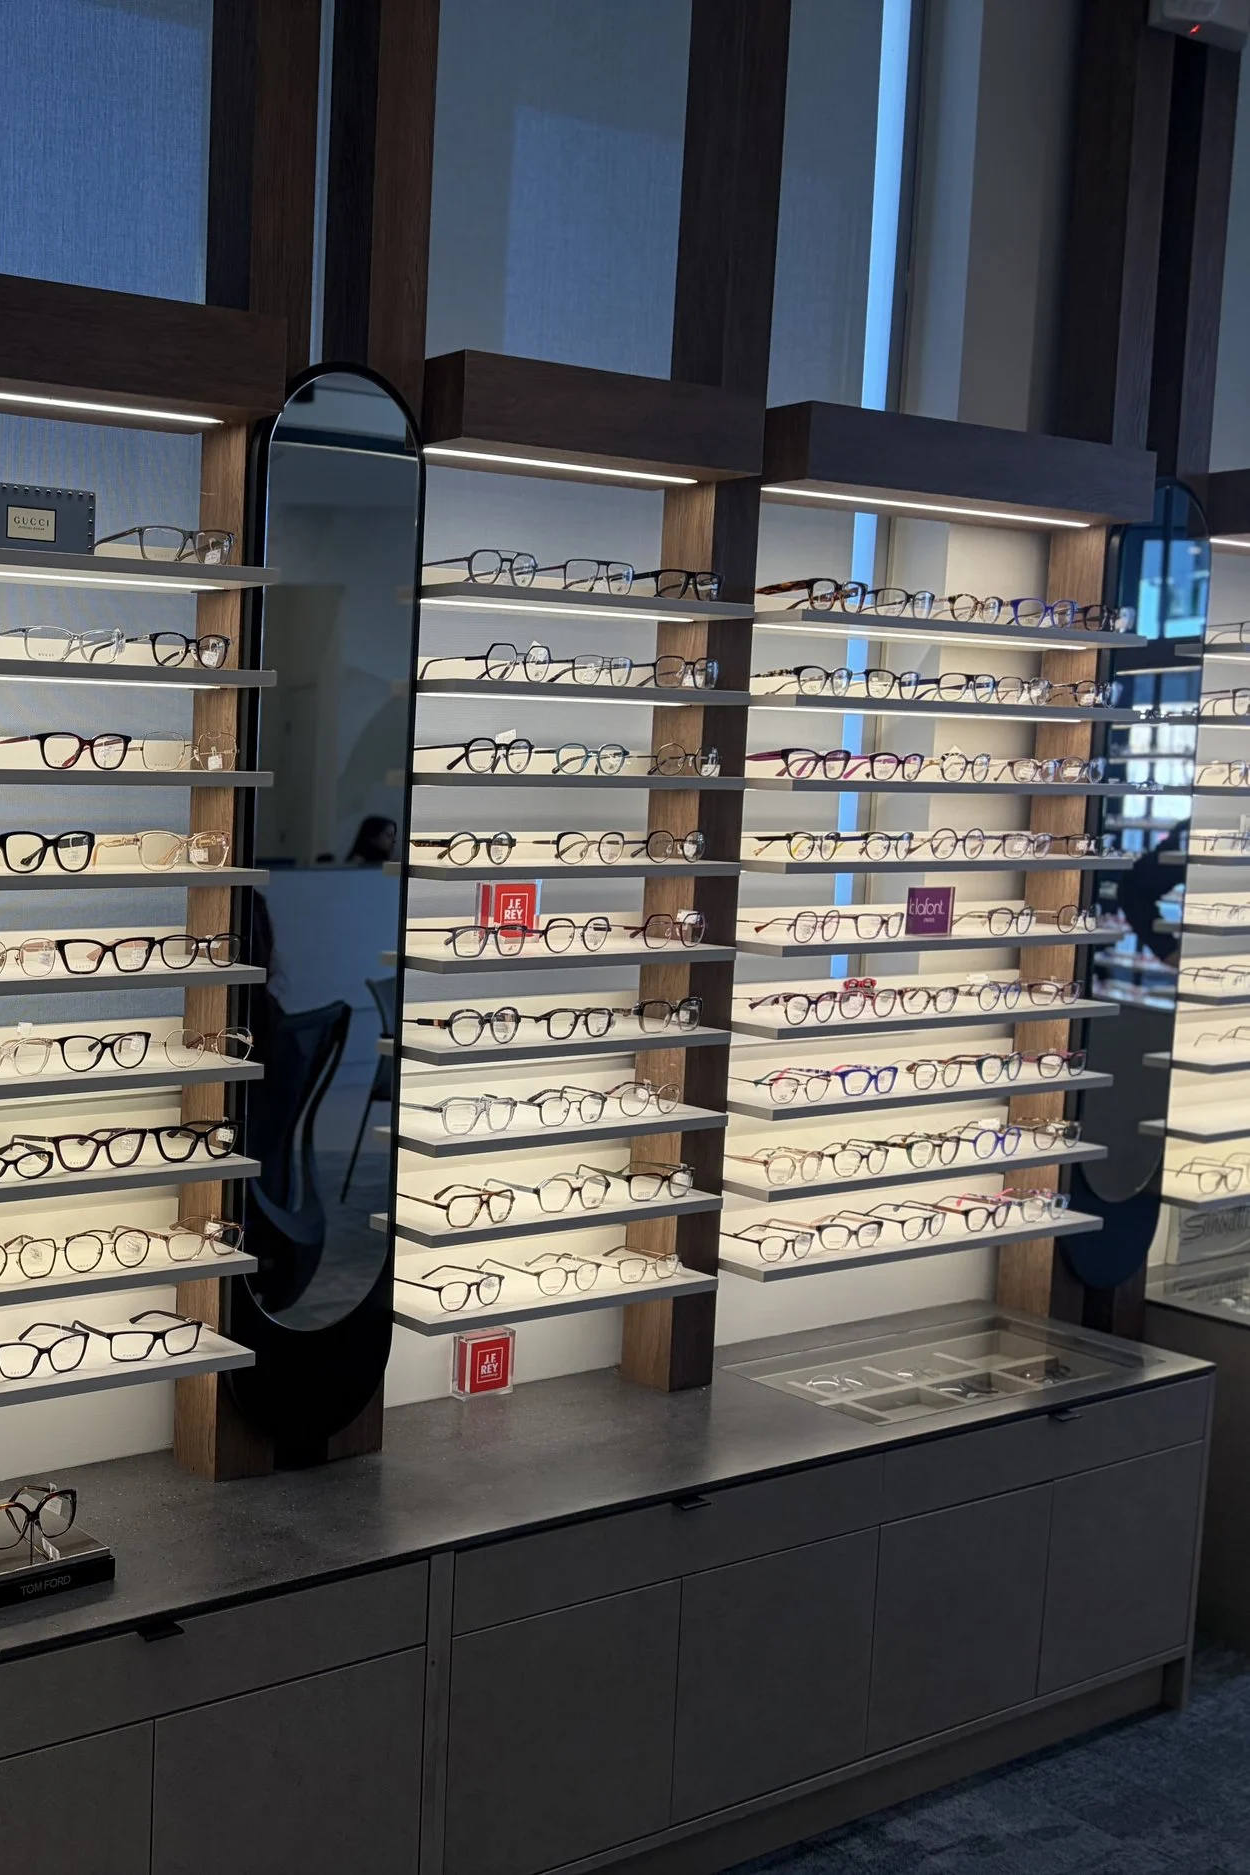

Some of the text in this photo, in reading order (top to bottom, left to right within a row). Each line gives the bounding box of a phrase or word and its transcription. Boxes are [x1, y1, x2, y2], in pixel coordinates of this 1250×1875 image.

[13, 516, 49, 527] GUCCI
[507, 898, 521, 909] J.F.
[504, 909, 523, 920] REY
[480, 1363, 499, 1375] REY
[20, 1575, 71, 1597] TOM FORD
